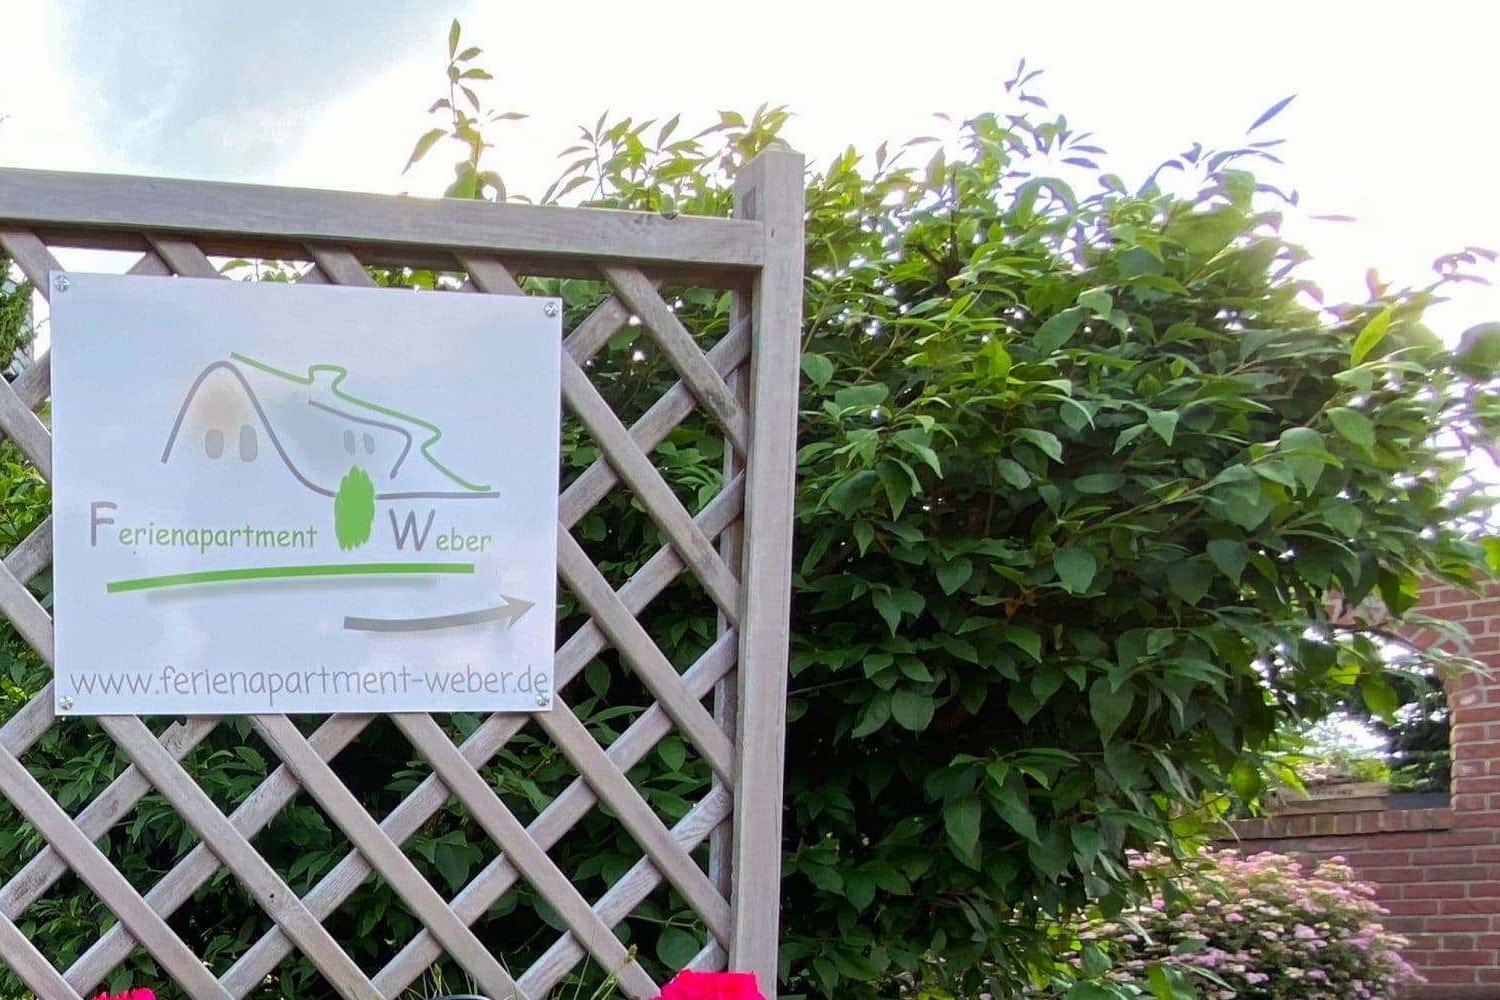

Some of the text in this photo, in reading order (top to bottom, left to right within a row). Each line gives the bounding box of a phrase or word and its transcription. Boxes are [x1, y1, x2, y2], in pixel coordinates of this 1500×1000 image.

[90, 501, 492, 553] Ferienapartment Weber
[70, 665, 548, 706] www.ferienapartment-weber.de
